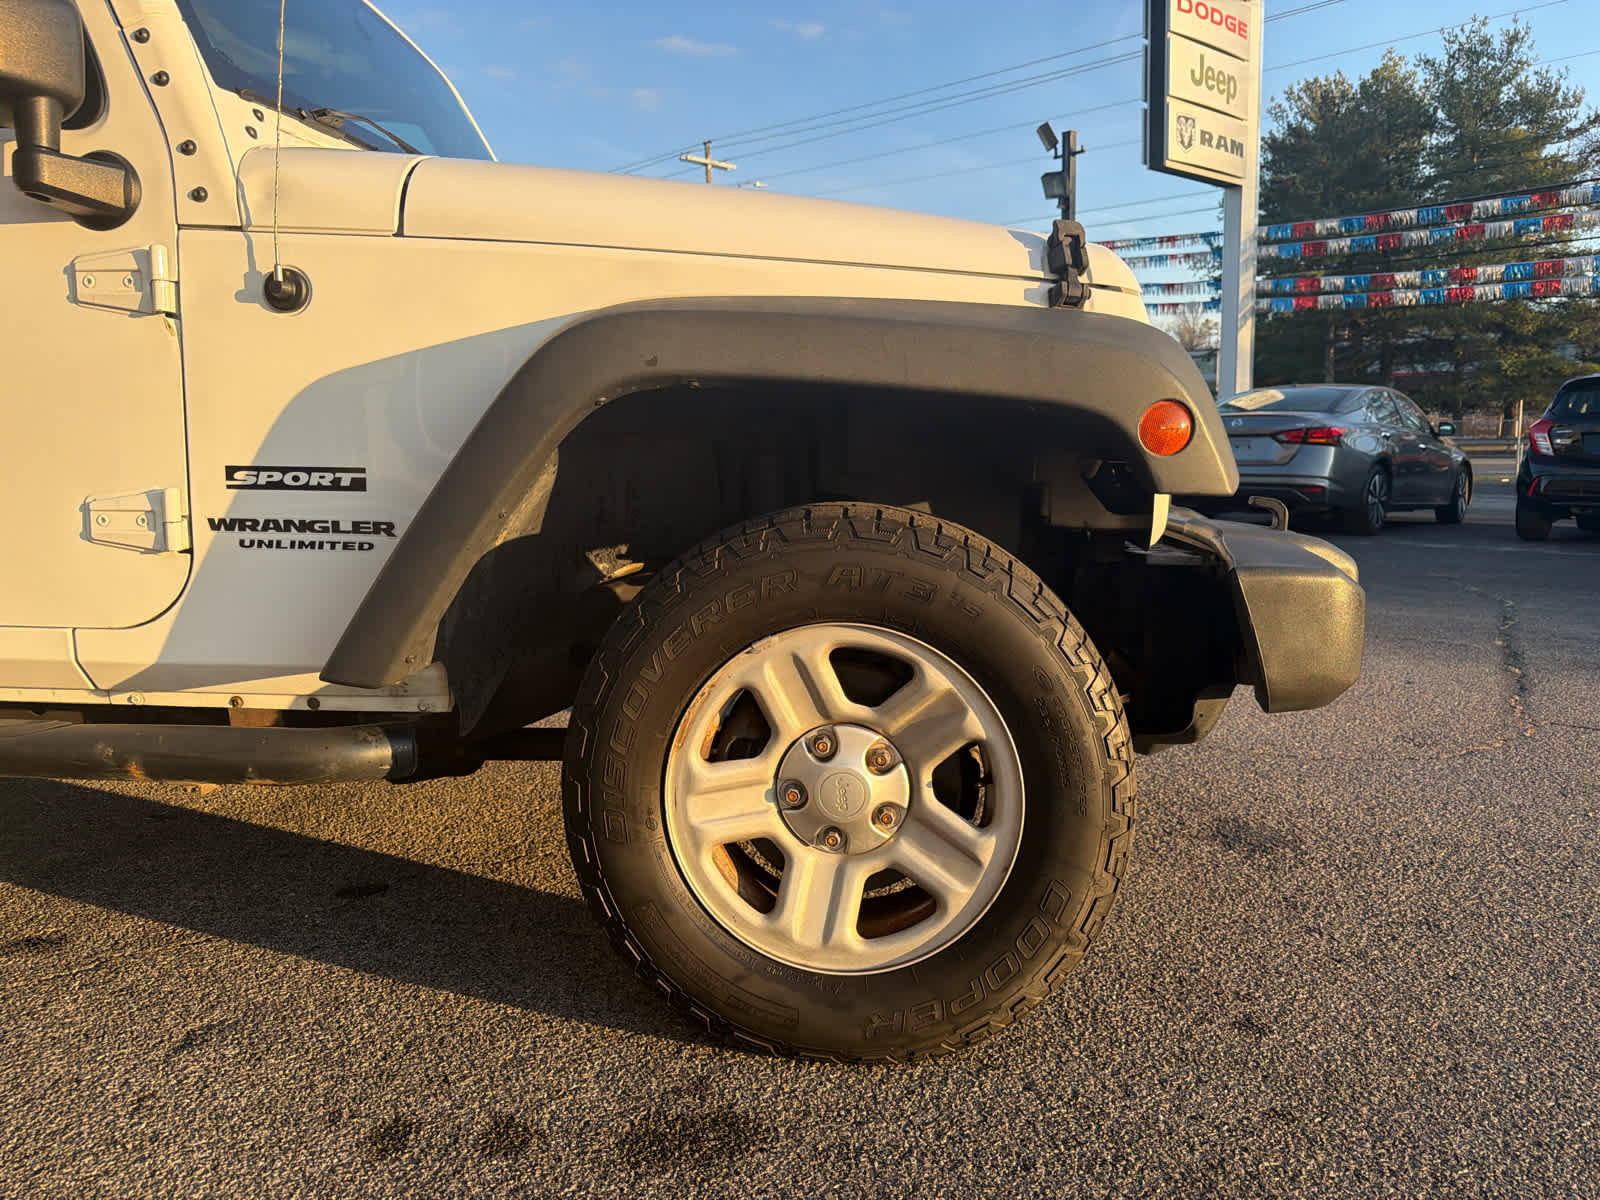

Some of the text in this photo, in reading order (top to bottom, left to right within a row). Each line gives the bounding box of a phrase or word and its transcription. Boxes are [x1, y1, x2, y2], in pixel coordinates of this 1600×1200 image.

[1177, 0, 1248, 40] DODGE
[1190, 54, 1237, 104] Jeep
[1200, 129, 1244, 158] RAM
[228, 469, 367, 487] SPORT
[207, 517, 397, 537] WRANGLER
[239, 538, 375, 552] UNLIMITED
[603, 568, 800, 849] DISCOVERER
[864, 879, 1073, 1040] COOPER
